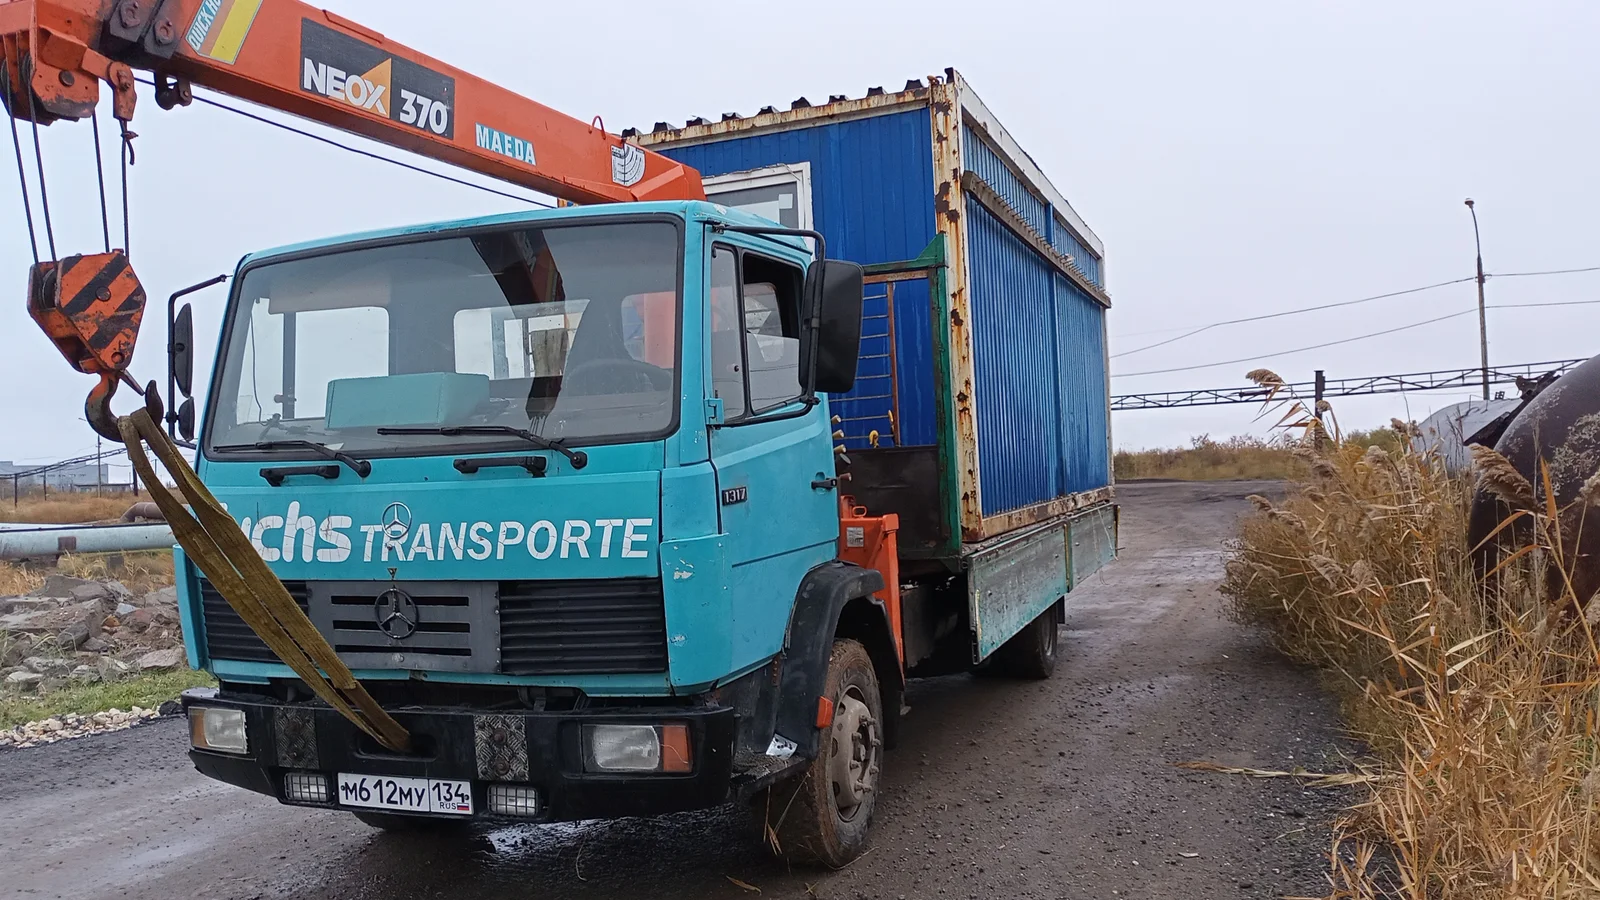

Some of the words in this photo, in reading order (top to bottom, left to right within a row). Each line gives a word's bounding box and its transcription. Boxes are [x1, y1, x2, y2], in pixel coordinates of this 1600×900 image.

[188, 5, 214, 51] QUICK
[303, 57, 387, 115] NEOX
[399, 89, 448, 134] 370
[475, 123, 537, 166] MAEDA
[725, 488, 746, 503] 1317
[360, 518, 653, 563] TRANSPORTE
[432, 782, 465, 803] 134
[439, 801, 457, 810] RUS
